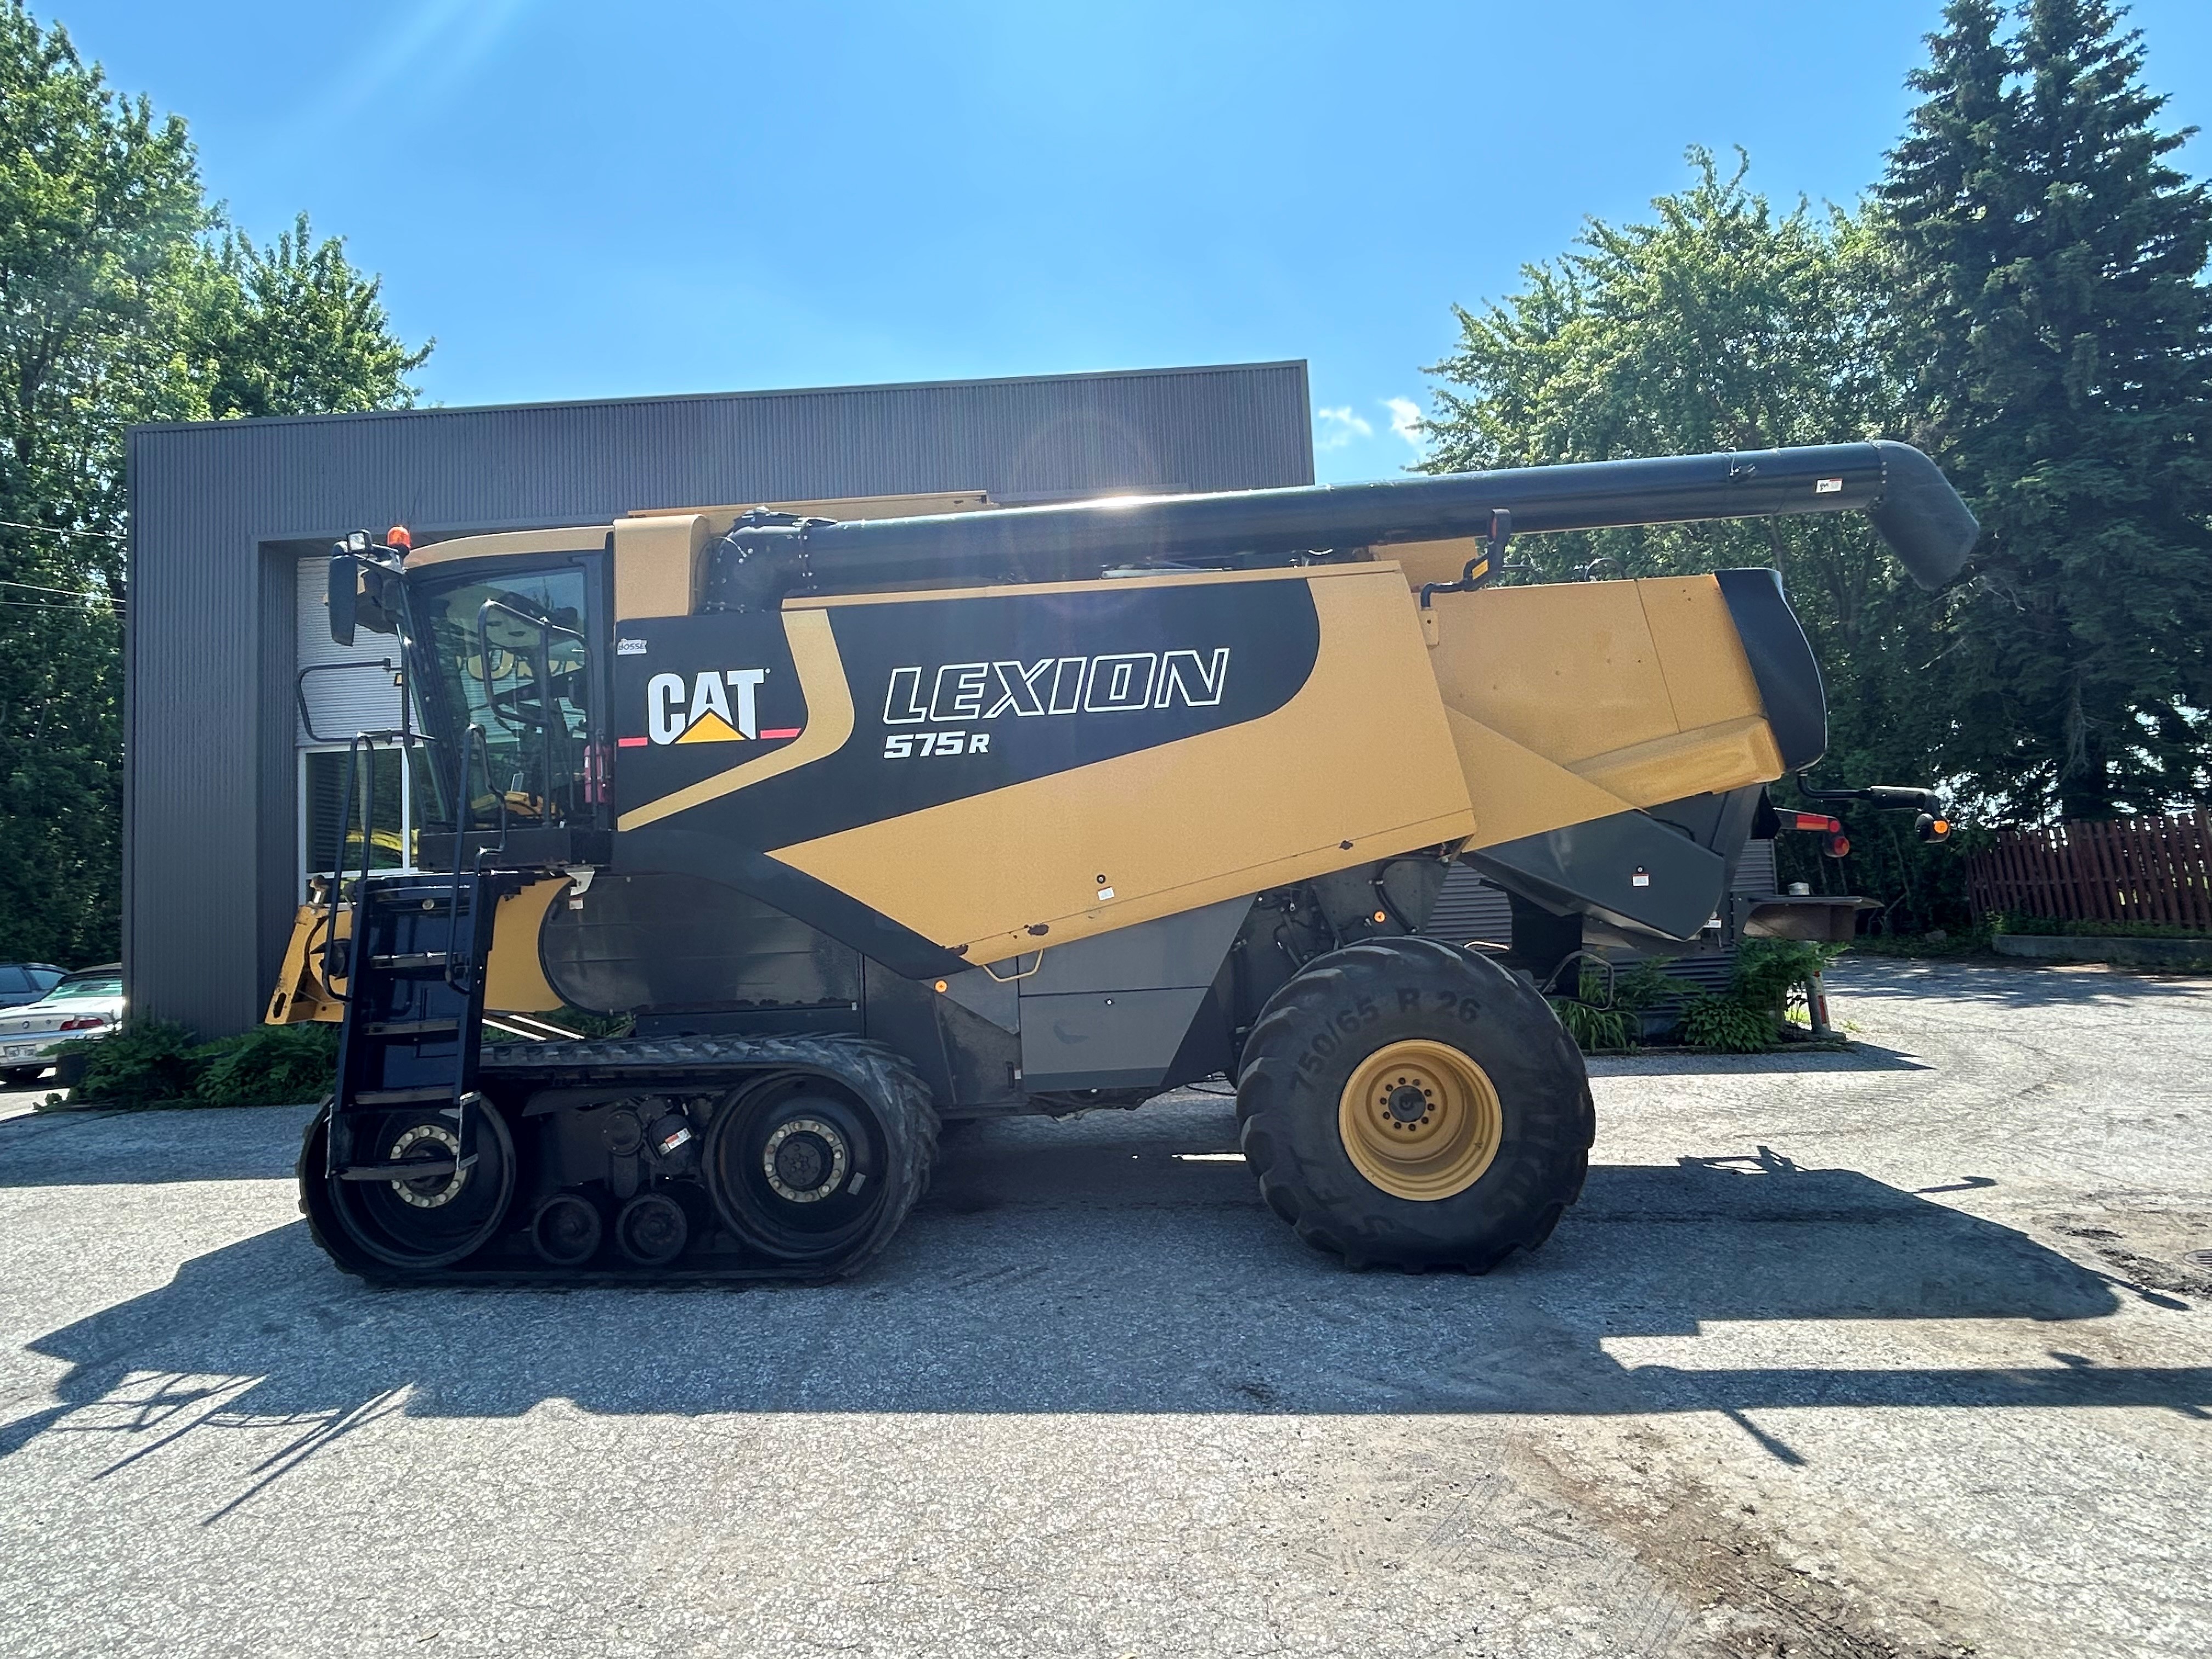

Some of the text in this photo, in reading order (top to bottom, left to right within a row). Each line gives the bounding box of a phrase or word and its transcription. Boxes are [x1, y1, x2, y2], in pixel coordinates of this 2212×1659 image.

[648, 669, 765, 745] CAT
[883, 648, 1230, 725] LEXION
[1291, 987, 1482, 1094] 750/65 R 26
